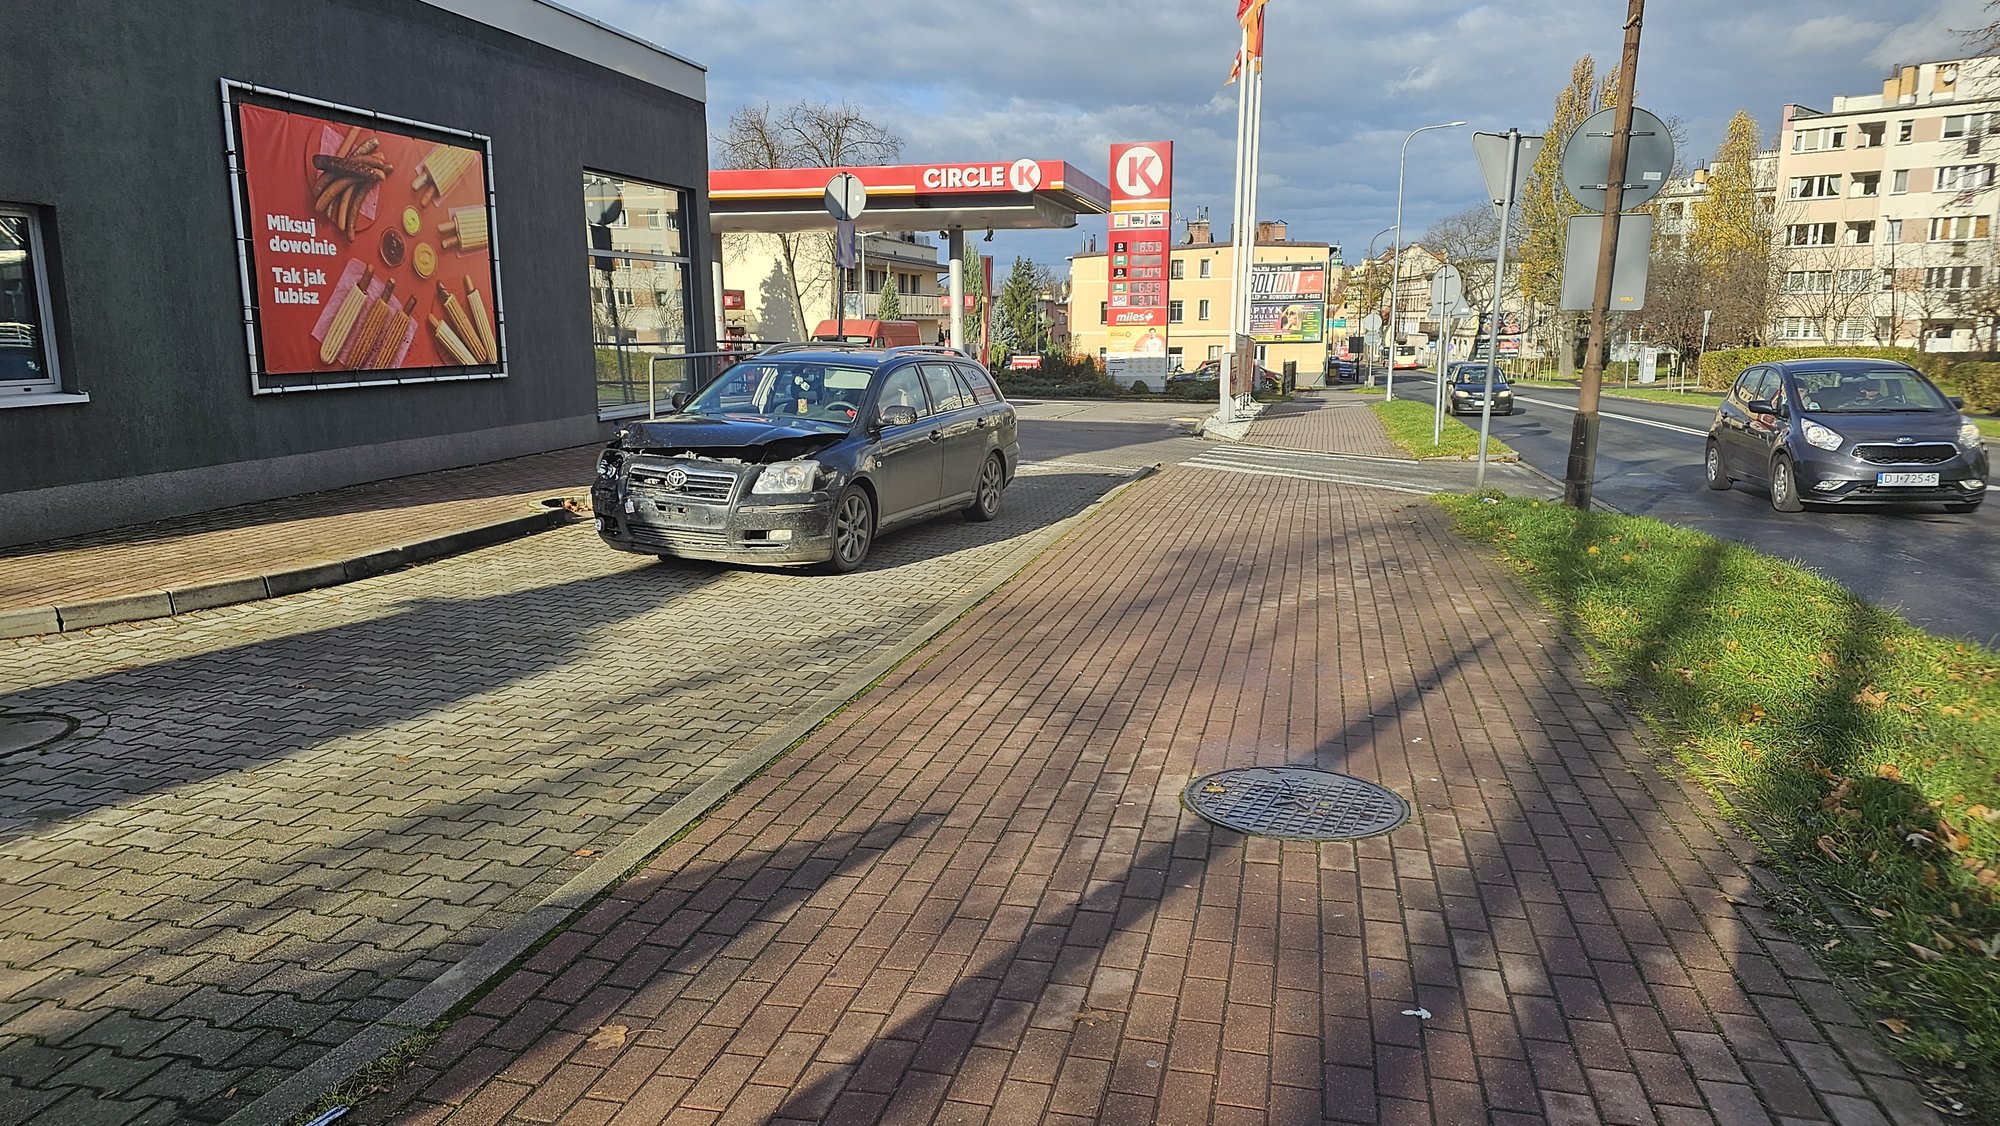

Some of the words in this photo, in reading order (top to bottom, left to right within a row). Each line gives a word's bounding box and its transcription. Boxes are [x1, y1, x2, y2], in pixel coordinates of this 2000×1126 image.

[922, 166, 1005, 188] CIRCLE
[1018, 165, 1036, 187] K
[1128, 155, 1159, 195] K
[267, 214, 316, 237] Miksuj
[269, 235, 337, 255] dowolnie
[271, 266, 301, 284] Tak
[303, 268, 327, 287] jak
[274, 286, 320, 304] lubisz
[1884, 474, 1899, 484] DJ
[1904, 474, 1937, 484] 72545
